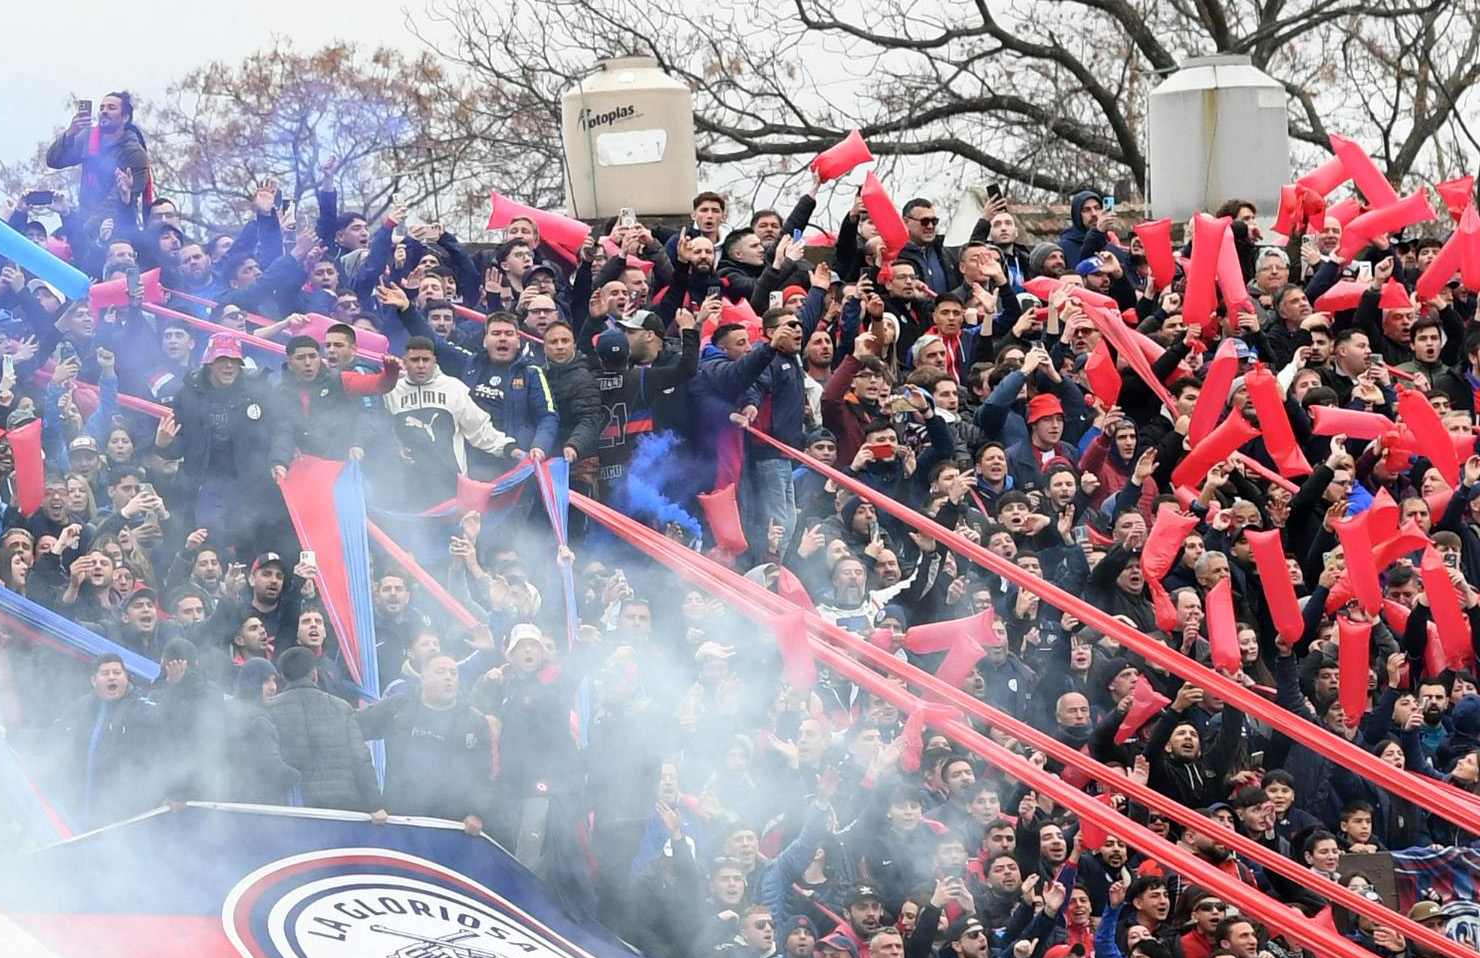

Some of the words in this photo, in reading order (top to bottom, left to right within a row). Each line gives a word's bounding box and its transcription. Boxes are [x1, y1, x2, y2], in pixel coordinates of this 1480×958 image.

[400, 390, 447, 409] PUMA
[307, 915, 352, 942] LA
[335, 896, 540, 953] GLORIOSA
